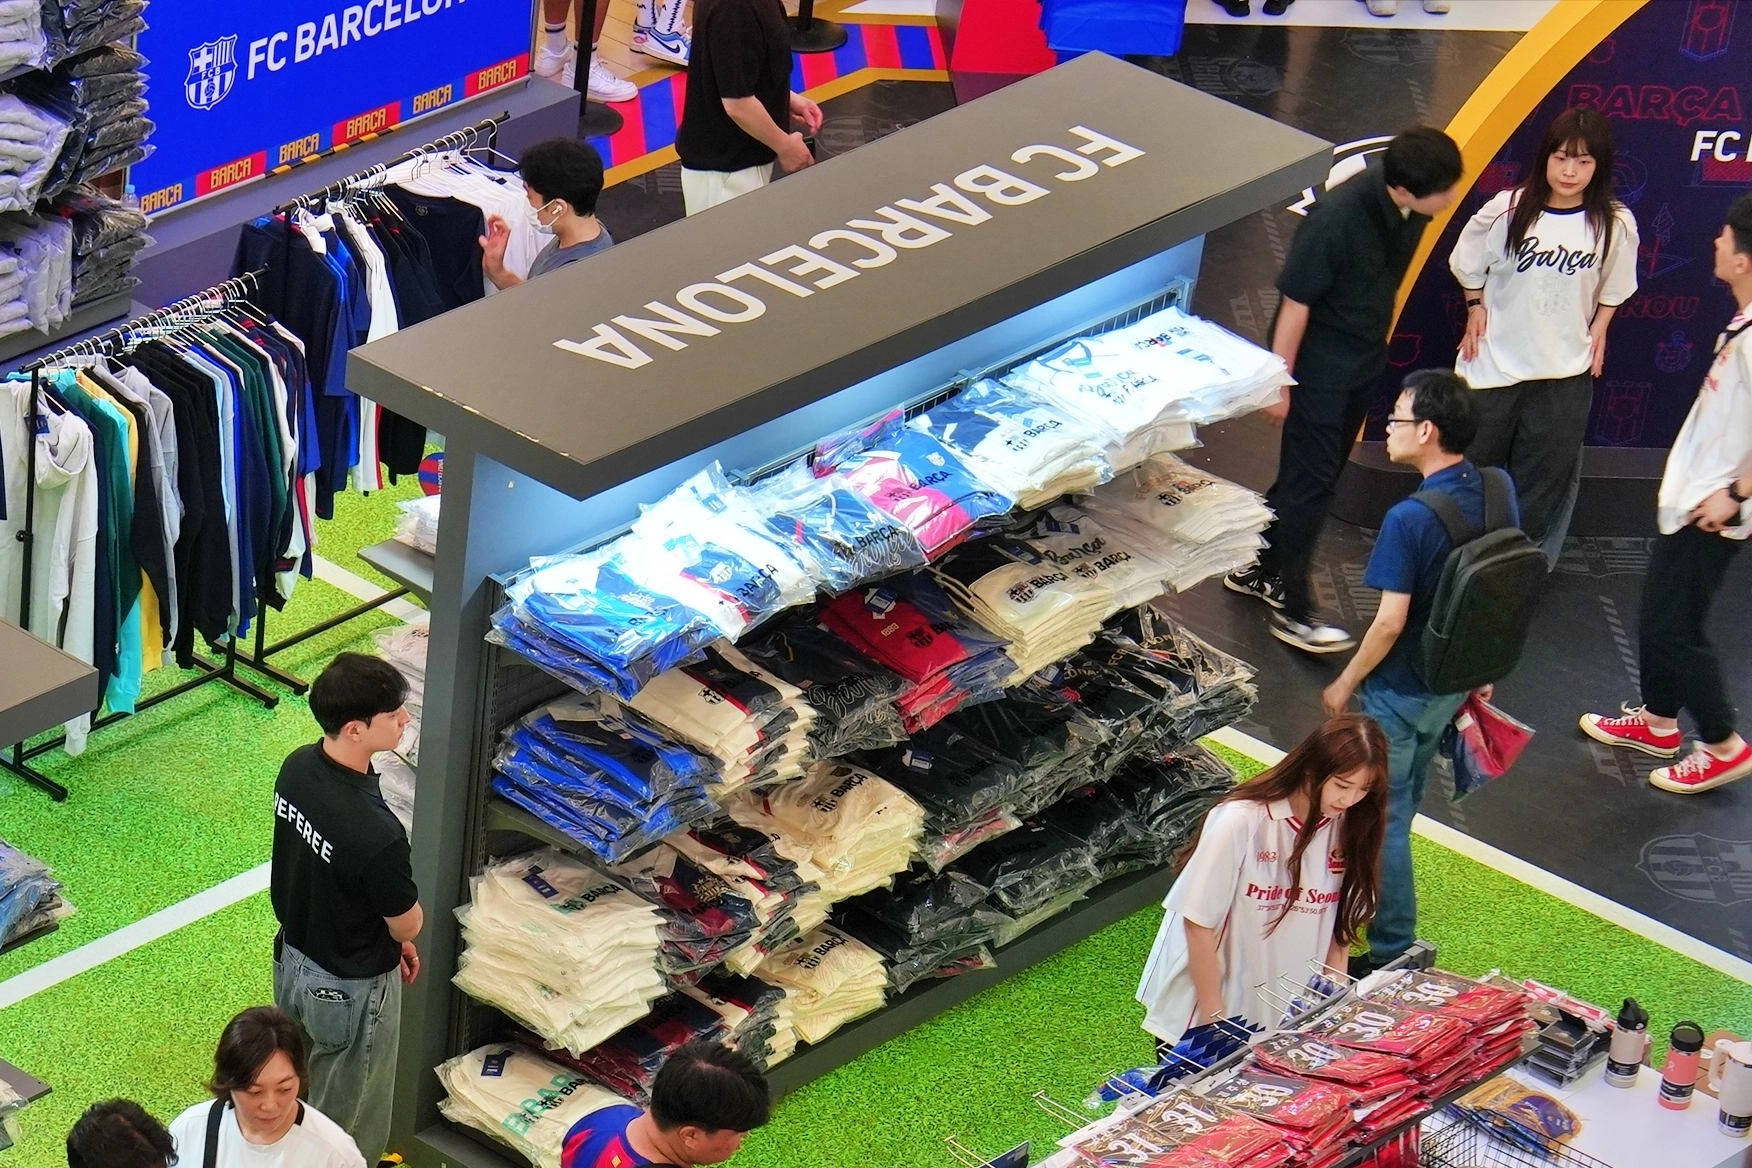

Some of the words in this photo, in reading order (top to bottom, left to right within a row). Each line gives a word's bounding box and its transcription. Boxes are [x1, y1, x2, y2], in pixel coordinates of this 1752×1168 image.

[247, 31, 288, 81] FC
[294, 0, 466, 63] BARCELO
[478, 60, 516, 90] BARÇA
[413, 84, 452, 113] BARÇA
[1567, 84, 1742, 127] BARÇA
[346, 109, 386, 138] BARÇA
[280, 134, 319, 162] BARÇA
[1010, 125, 1147, 182] FC
[1690, 130, 1742, 162] FC
[210, 158, 252, 188] BARÇA
[141, 183, 182, 213] BARÇA
[552, 164, 1051, 370] BARCELONA
[1517, 236, 1598, 275] Barça
[909, 469, 952, 491] BARÇA
[855, 525, 899, 549] BARÇA
[830, 771, 868, 801] BARÇA
[582, 881, 624, 903] BARÇA
[1246, 882, 1283, 902] Pride
[1306, 888, 1341, 905] Seou
[1340, 1010, 1396, 1040] 30
[1108, 1132, 1165, 1163] 31
